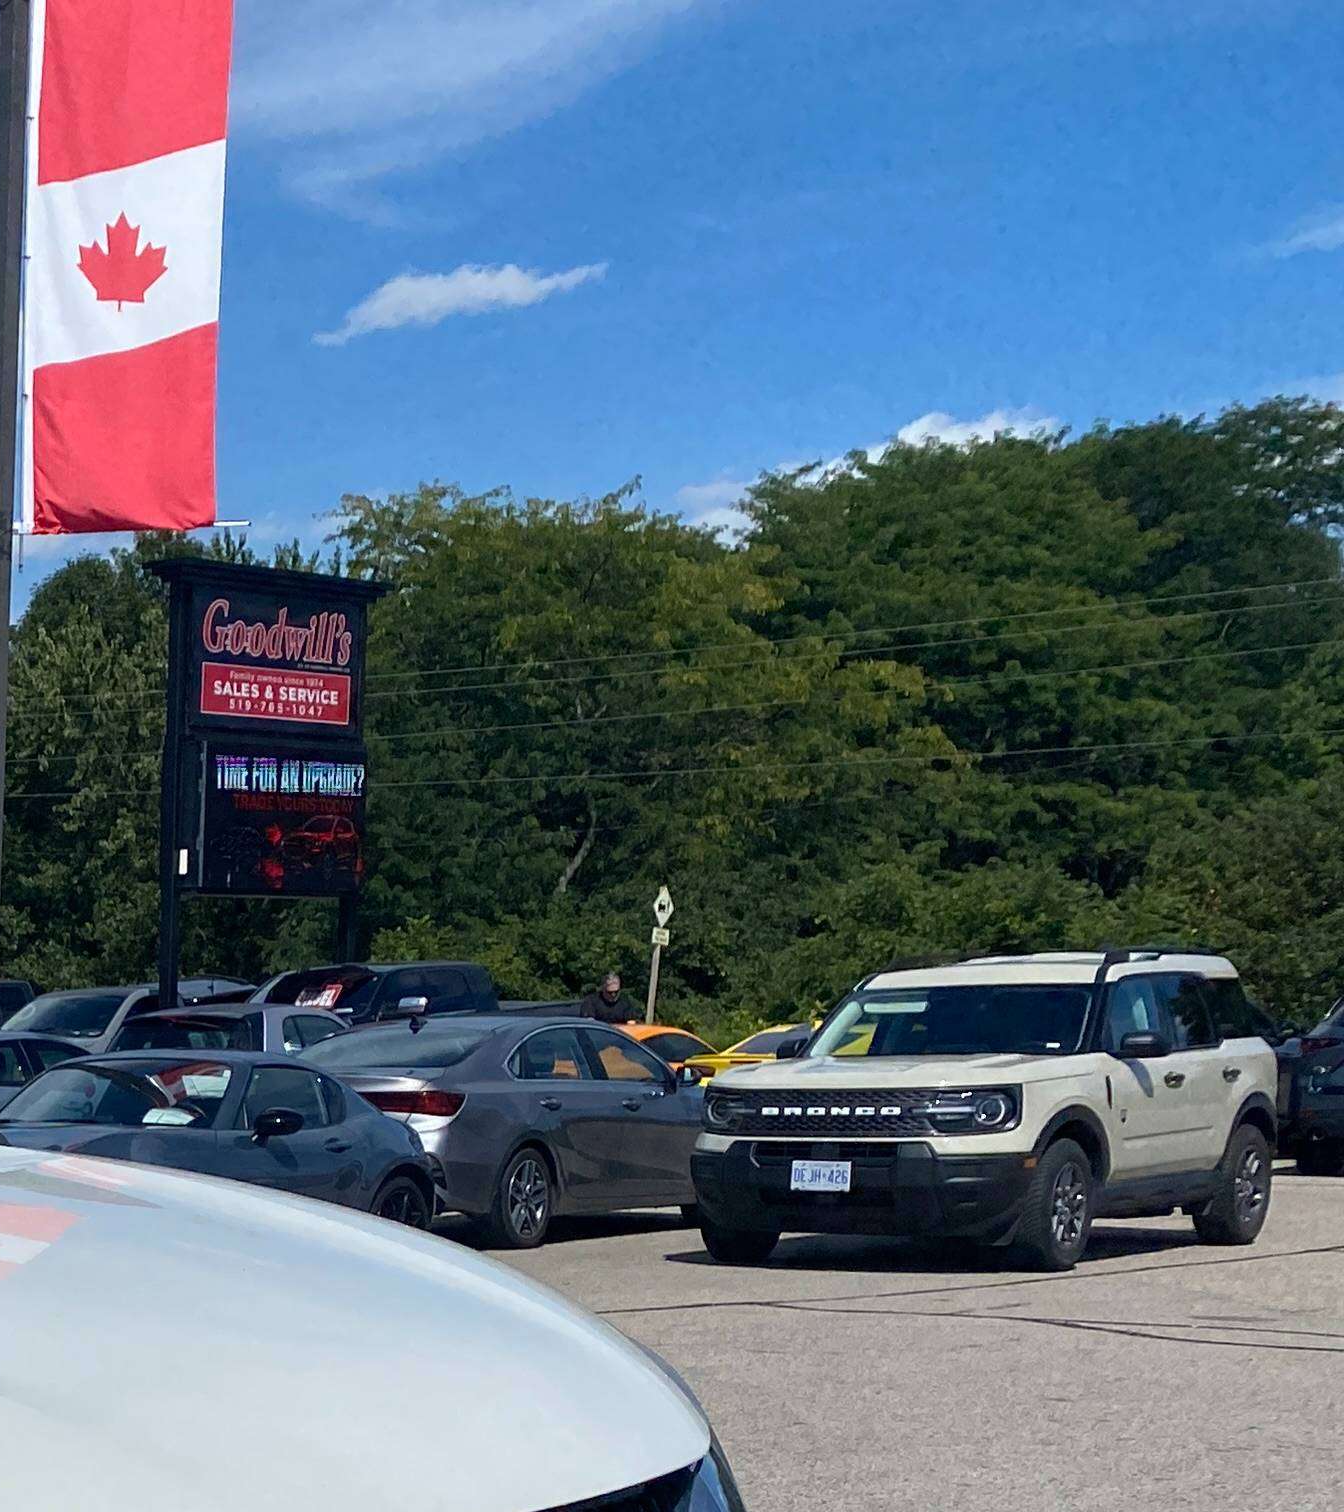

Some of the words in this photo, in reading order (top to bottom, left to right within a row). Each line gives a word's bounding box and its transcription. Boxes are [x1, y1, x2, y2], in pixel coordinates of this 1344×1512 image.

[203, 599, 352, 666] Goodwill's
[214, 680, 260, 698] SALES
[265, 685, 274, 700] &
[279, 686, 339, 705] SERVICE
[761, 1106, 902, 1116] BRONCO
